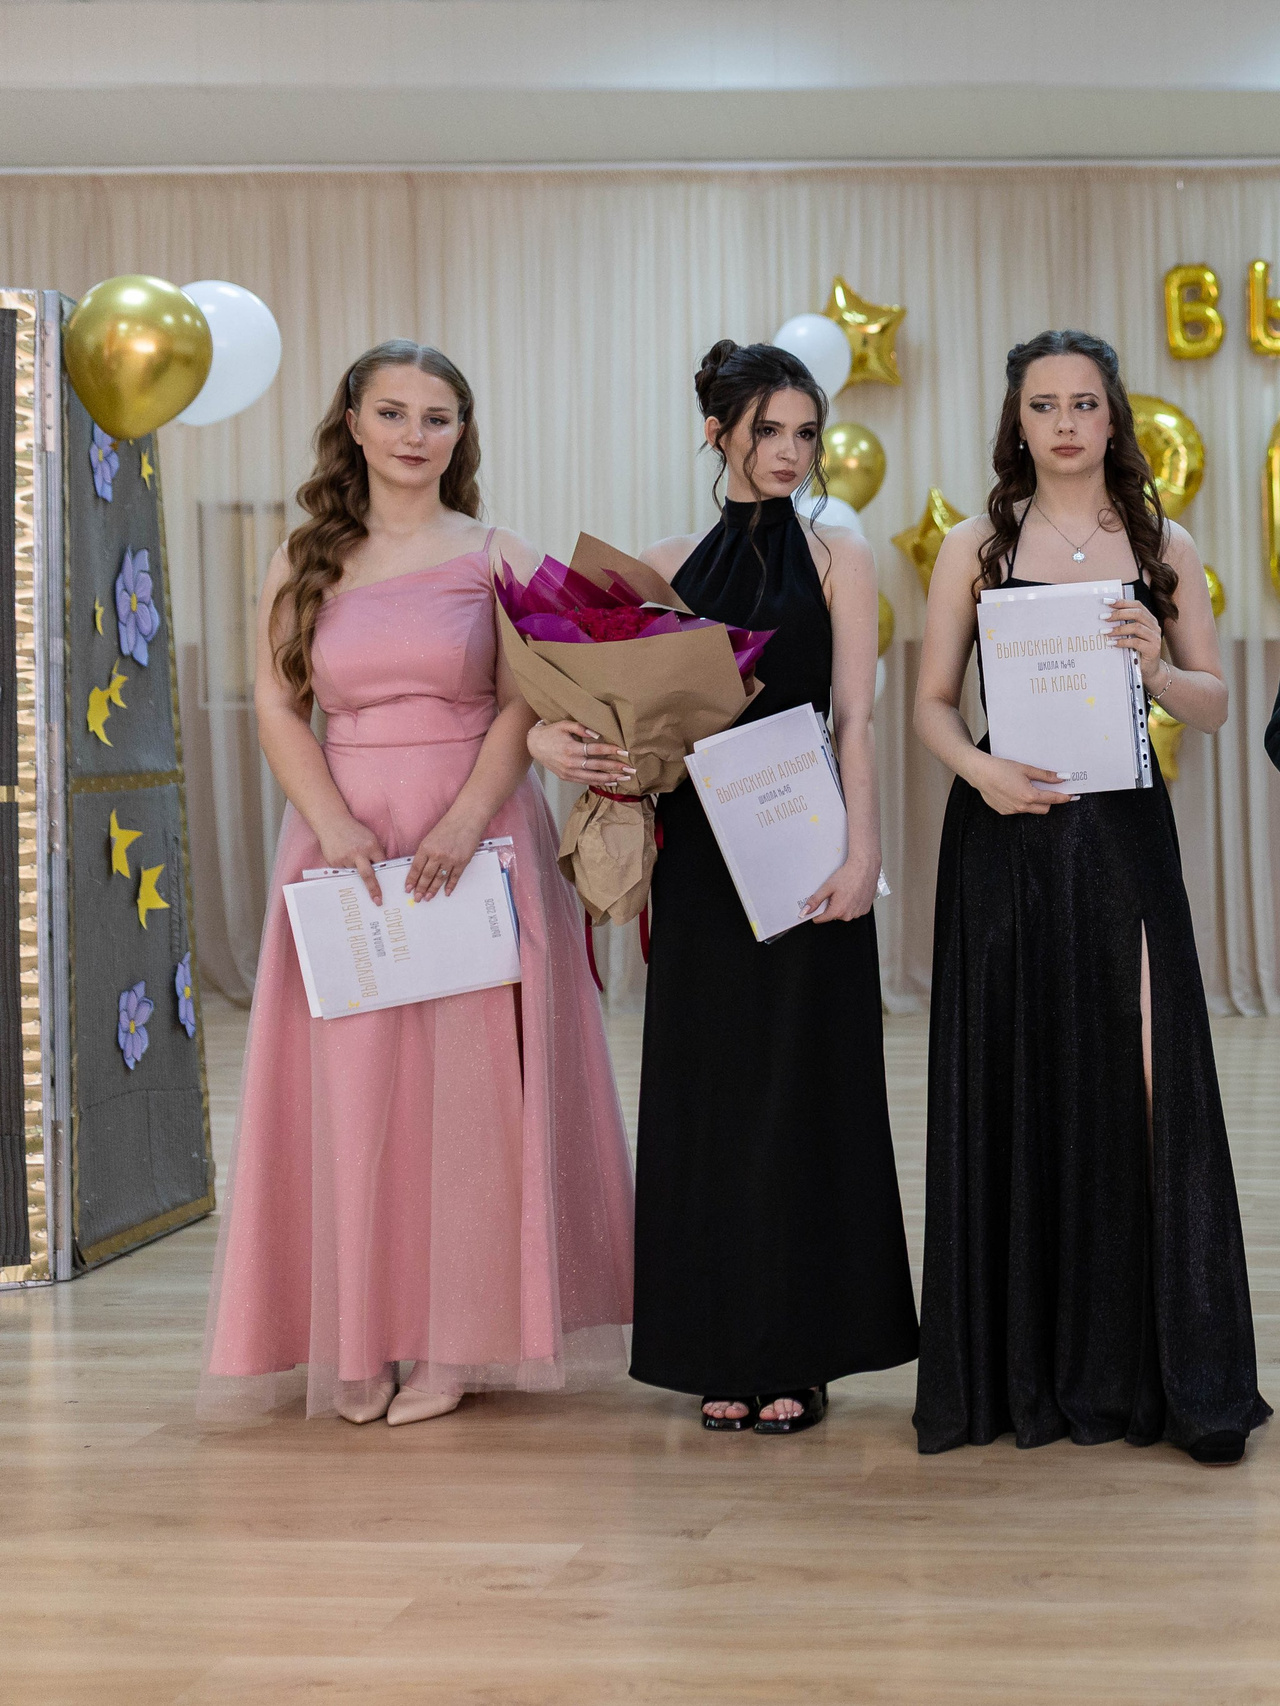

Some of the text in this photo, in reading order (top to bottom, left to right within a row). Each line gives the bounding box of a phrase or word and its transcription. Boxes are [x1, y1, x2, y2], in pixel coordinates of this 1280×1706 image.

[996, 635, 1063, 659] ВЫПУСКНОЙ
[1037, 660, 1059, 671] ШКОЛА
[1029, 673, 1087, 694] 11А КЛАСС
[716, 750, 819, 804] ВЫПУСКНОЙ АЛЬБОМ
[1071, 771, 1088, 781] 2026
[758, 790, 778, 805] ШКОЛА
[755, 795, 808, 828] 11А КЛАСС
[339, 887, 379, 998] ВЫПУСКНОЙ АЛЬБОМ
[384, 907, 411, 963] 11А КЛАСС
[373, 936, 386, 958] ШКОЛА
